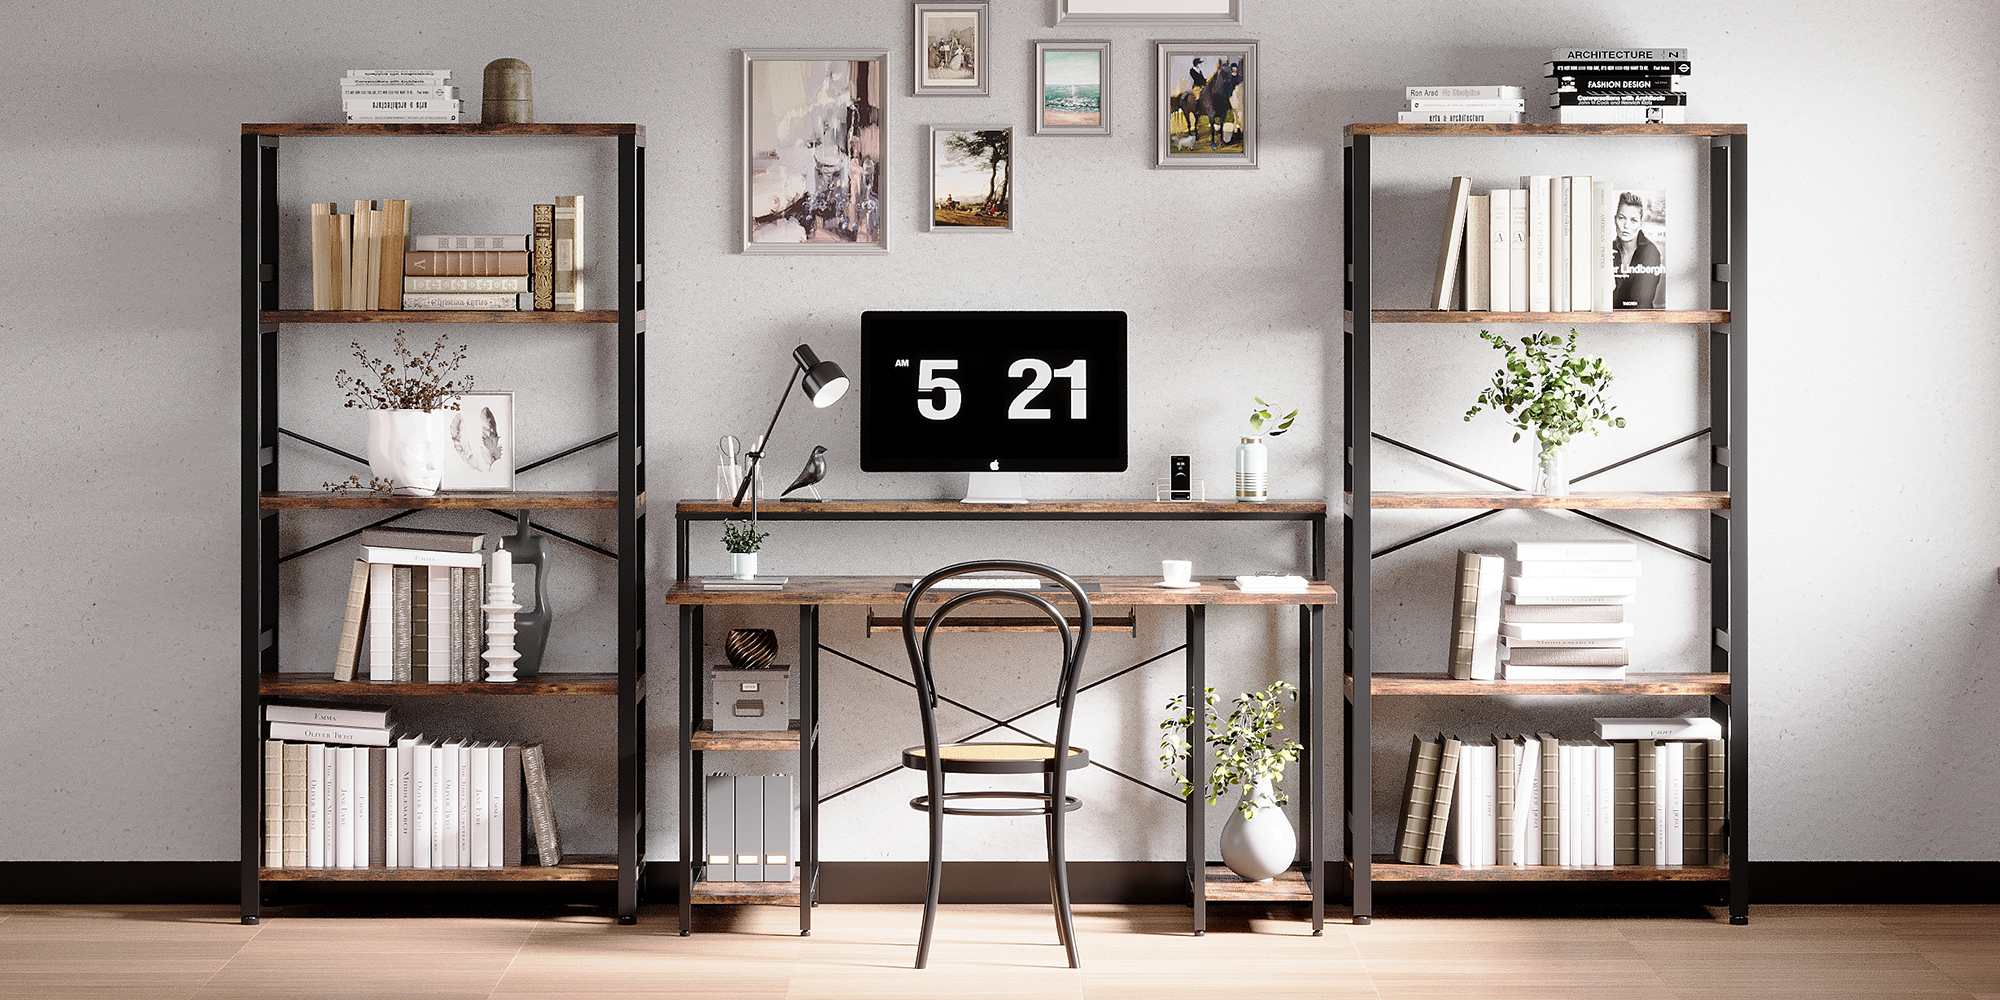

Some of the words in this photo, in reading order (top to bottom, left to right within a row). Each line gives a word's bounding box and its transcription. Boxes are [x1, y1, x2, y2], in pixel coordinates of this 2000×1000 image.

[1567, 51, 1653, 59] ARCHITECTURE
[1588, 80, 1620, 89] FASHION
[1622, 80, 1651, 89] DESIGN
[1410, 89, 1422, 97] Ron
[1424, 89, 1438, 97] Arad
[1442, 89, 1451, 97] No
[1452, 89, 1481, 97] Discipline
[1621, 264, 1666, 276] Lindbergh
[895, 359, 909, 367] AM
[917, 359, 962, 420] 5
[1008, 358, 1087, 419] 21
[314, 713, 336, 721] EMMA
[305, 730, 331, 738] OLIVER
